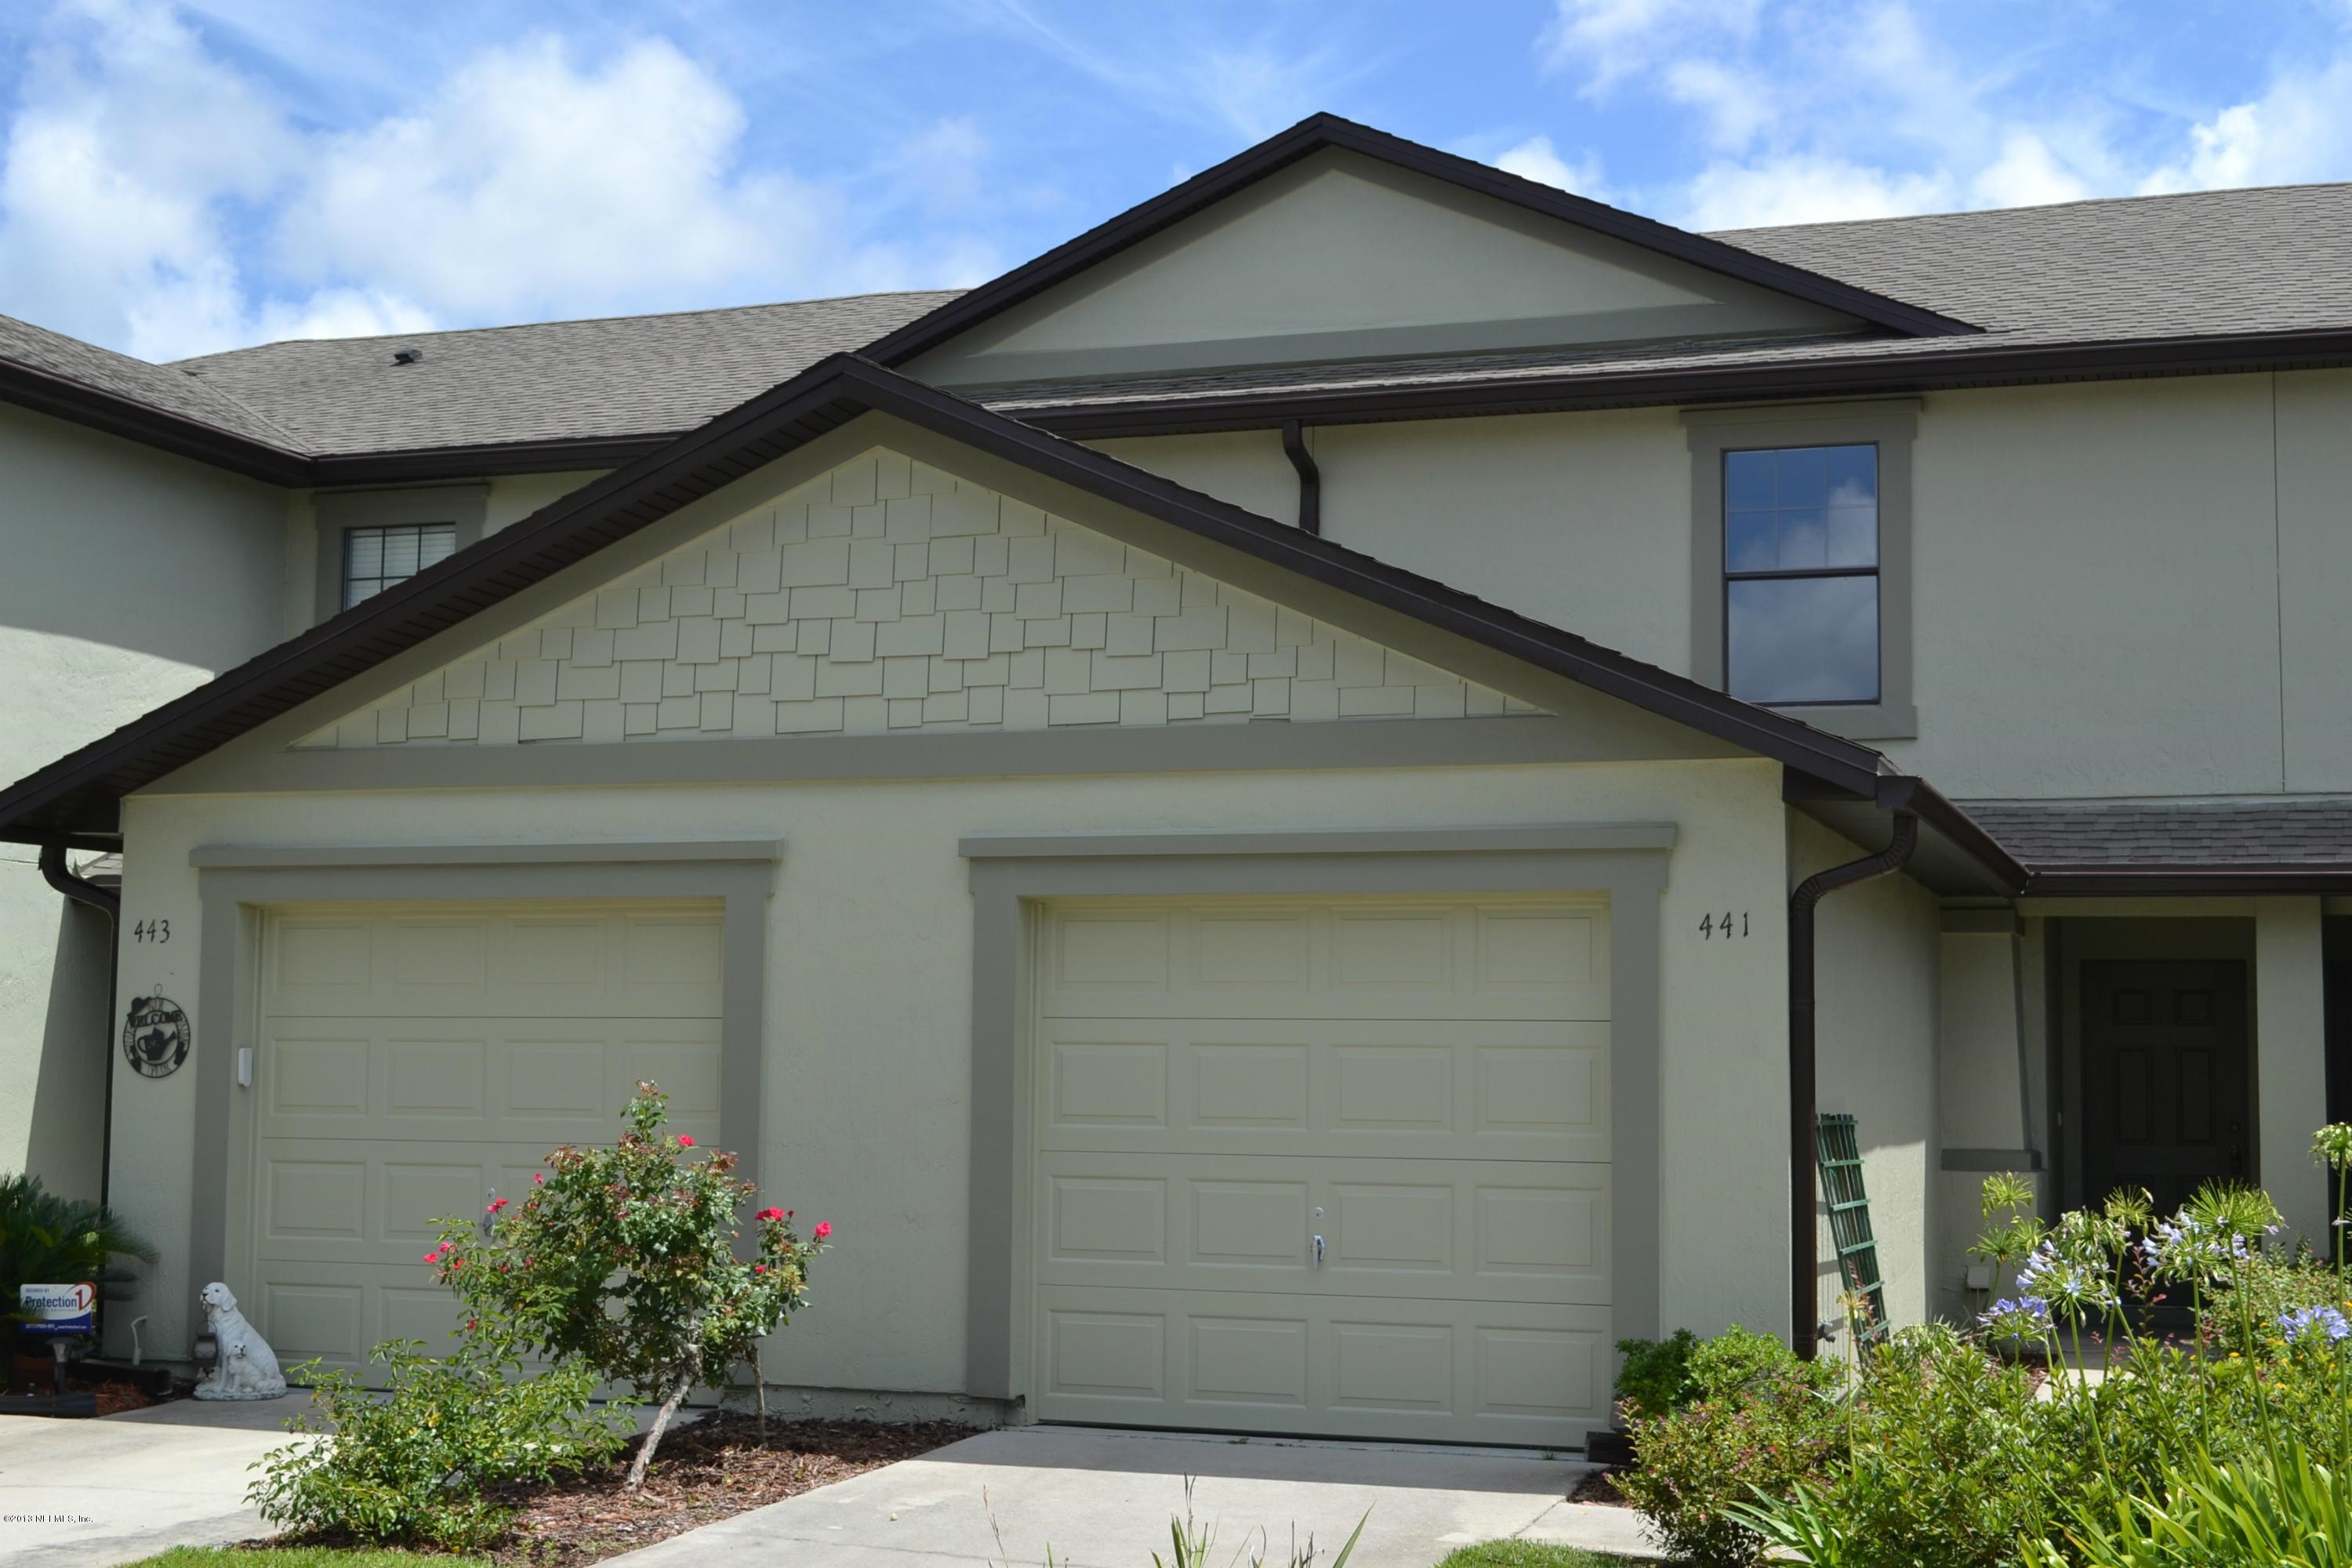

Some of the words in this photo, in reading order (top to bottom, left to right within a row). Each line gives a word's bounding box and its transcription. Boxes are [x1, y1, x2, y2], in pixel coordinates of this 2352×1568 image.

[134, 919, 170, 943] 443
[1699, 912, 1749, 941] 441
[25, 1295, 77, 1308] Protection
